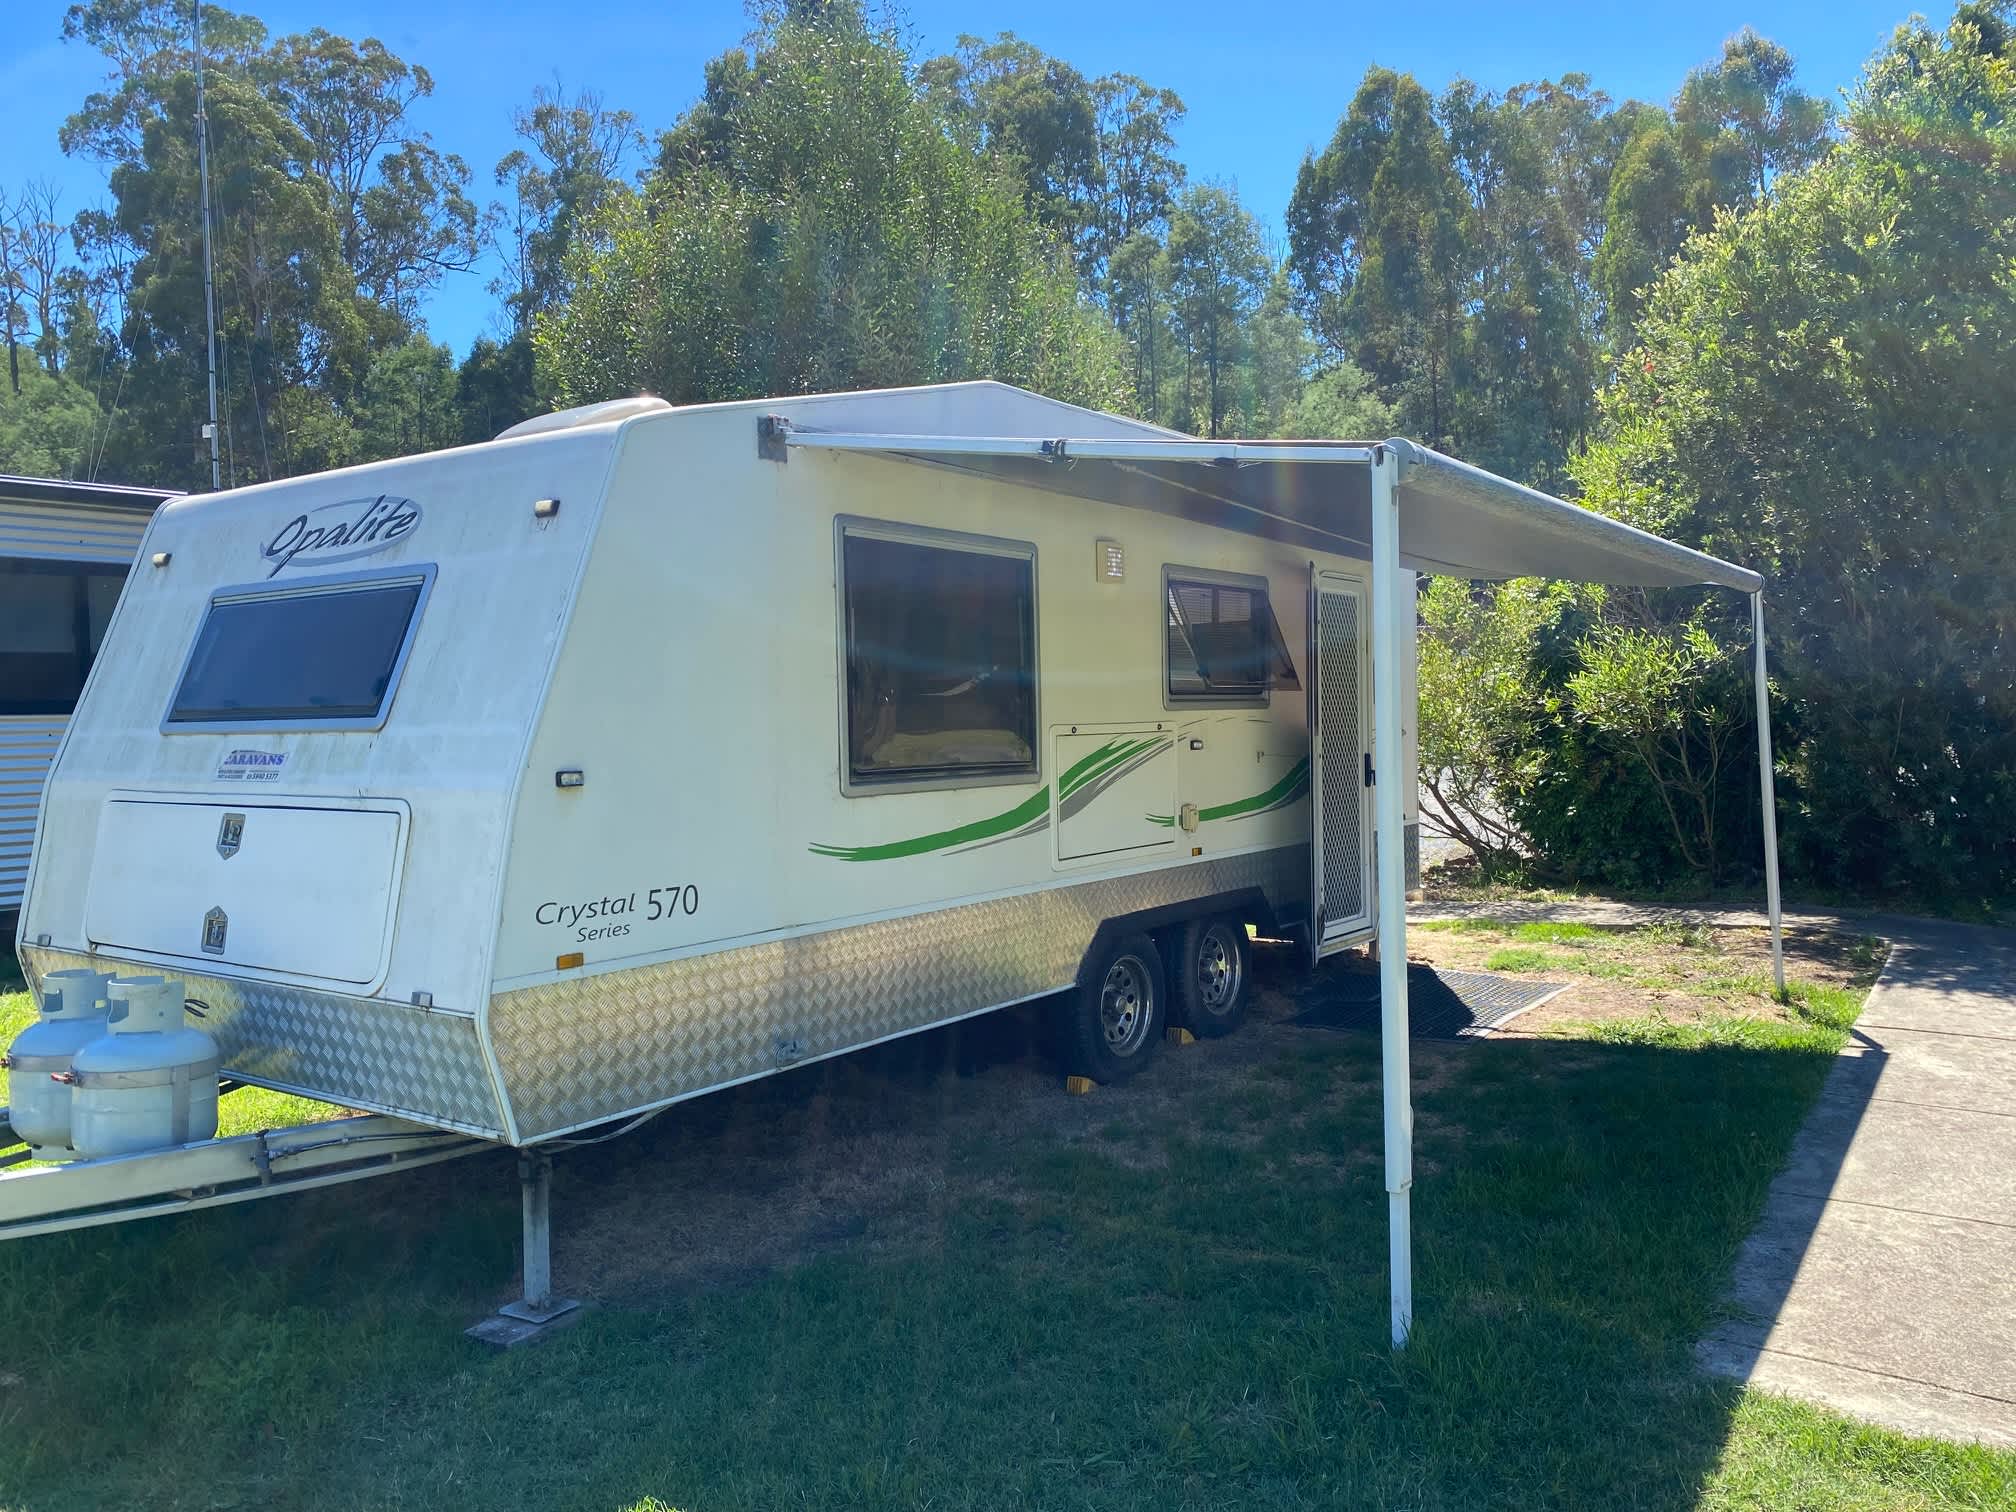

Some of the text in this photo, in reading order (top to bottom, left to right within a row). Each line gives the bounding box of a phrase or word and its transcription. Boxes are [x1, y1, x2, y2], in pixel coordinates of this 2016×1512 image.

[266, 494, 417, 579] Opalite
[535, 884, 699, 928] Crystal 570
[576, 922, 631, 943] Series
